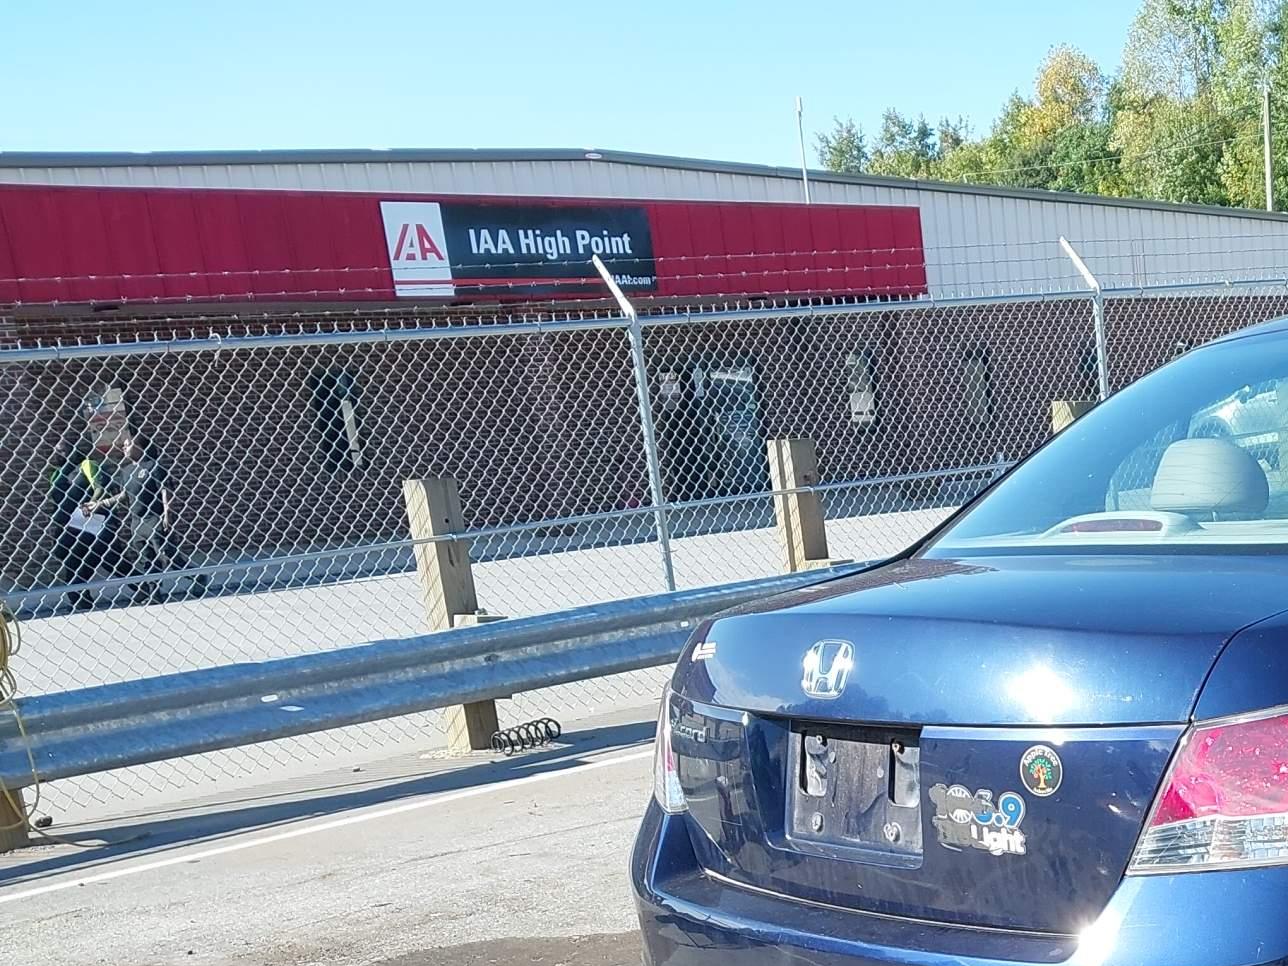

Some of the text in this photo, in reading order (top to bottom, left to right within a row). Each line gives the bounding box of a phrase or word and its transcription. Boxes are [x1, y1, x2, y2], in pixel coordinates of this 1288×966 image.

[468, 228, 633, 260] IAA High Point
